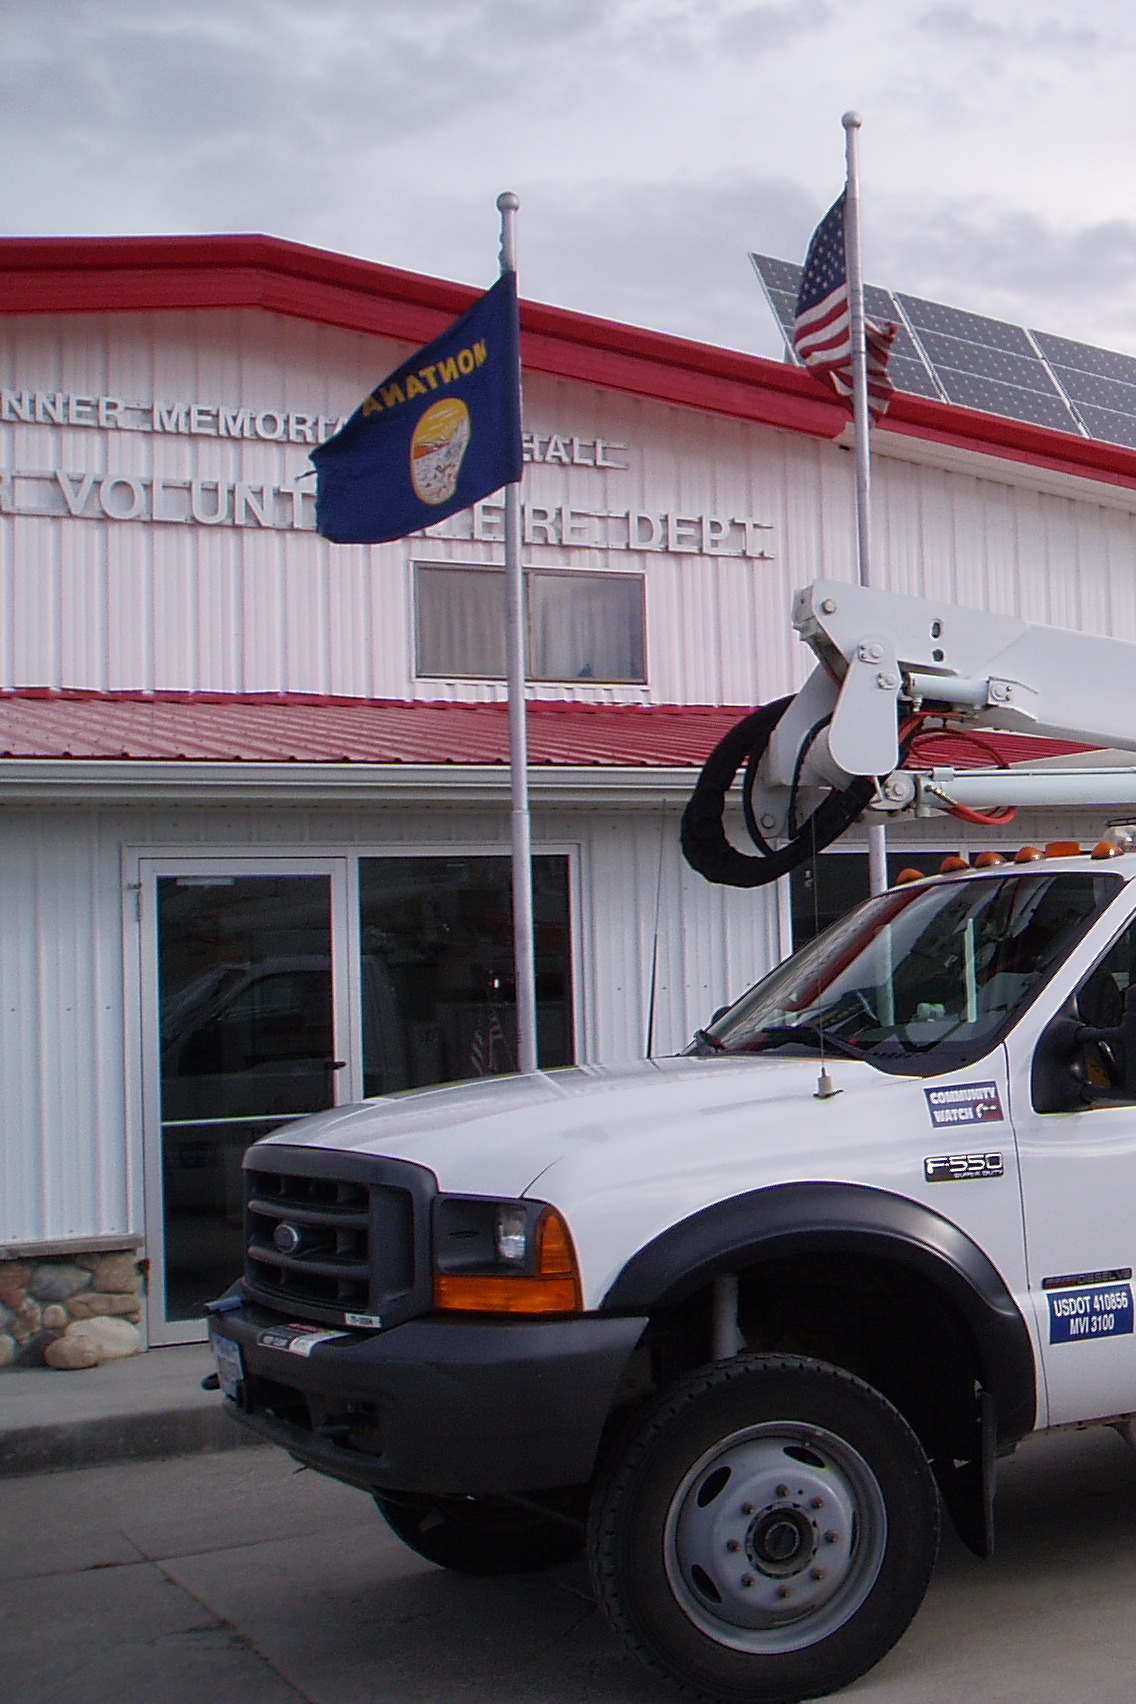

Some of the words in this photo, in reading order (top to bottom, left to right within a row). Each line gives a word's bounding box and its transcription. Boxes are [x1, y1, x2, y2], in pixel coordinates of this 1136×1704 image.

[1, 389, 124, 428] NNER
[151, 402, 347, 443] MEMORI
[56, 471, 317, 529] VOLUNT
[473, 503, 592, 547] FRE
[930, 1086, 996, 1105] COMMUNITY
[933, 1107, 974, 1123] WATCH
[1053, 1296, 1091, 1318] USDOT
[1070, 1316, 1089, 1336] MVI
[1090, 1313, 1115, 1333] 3100
